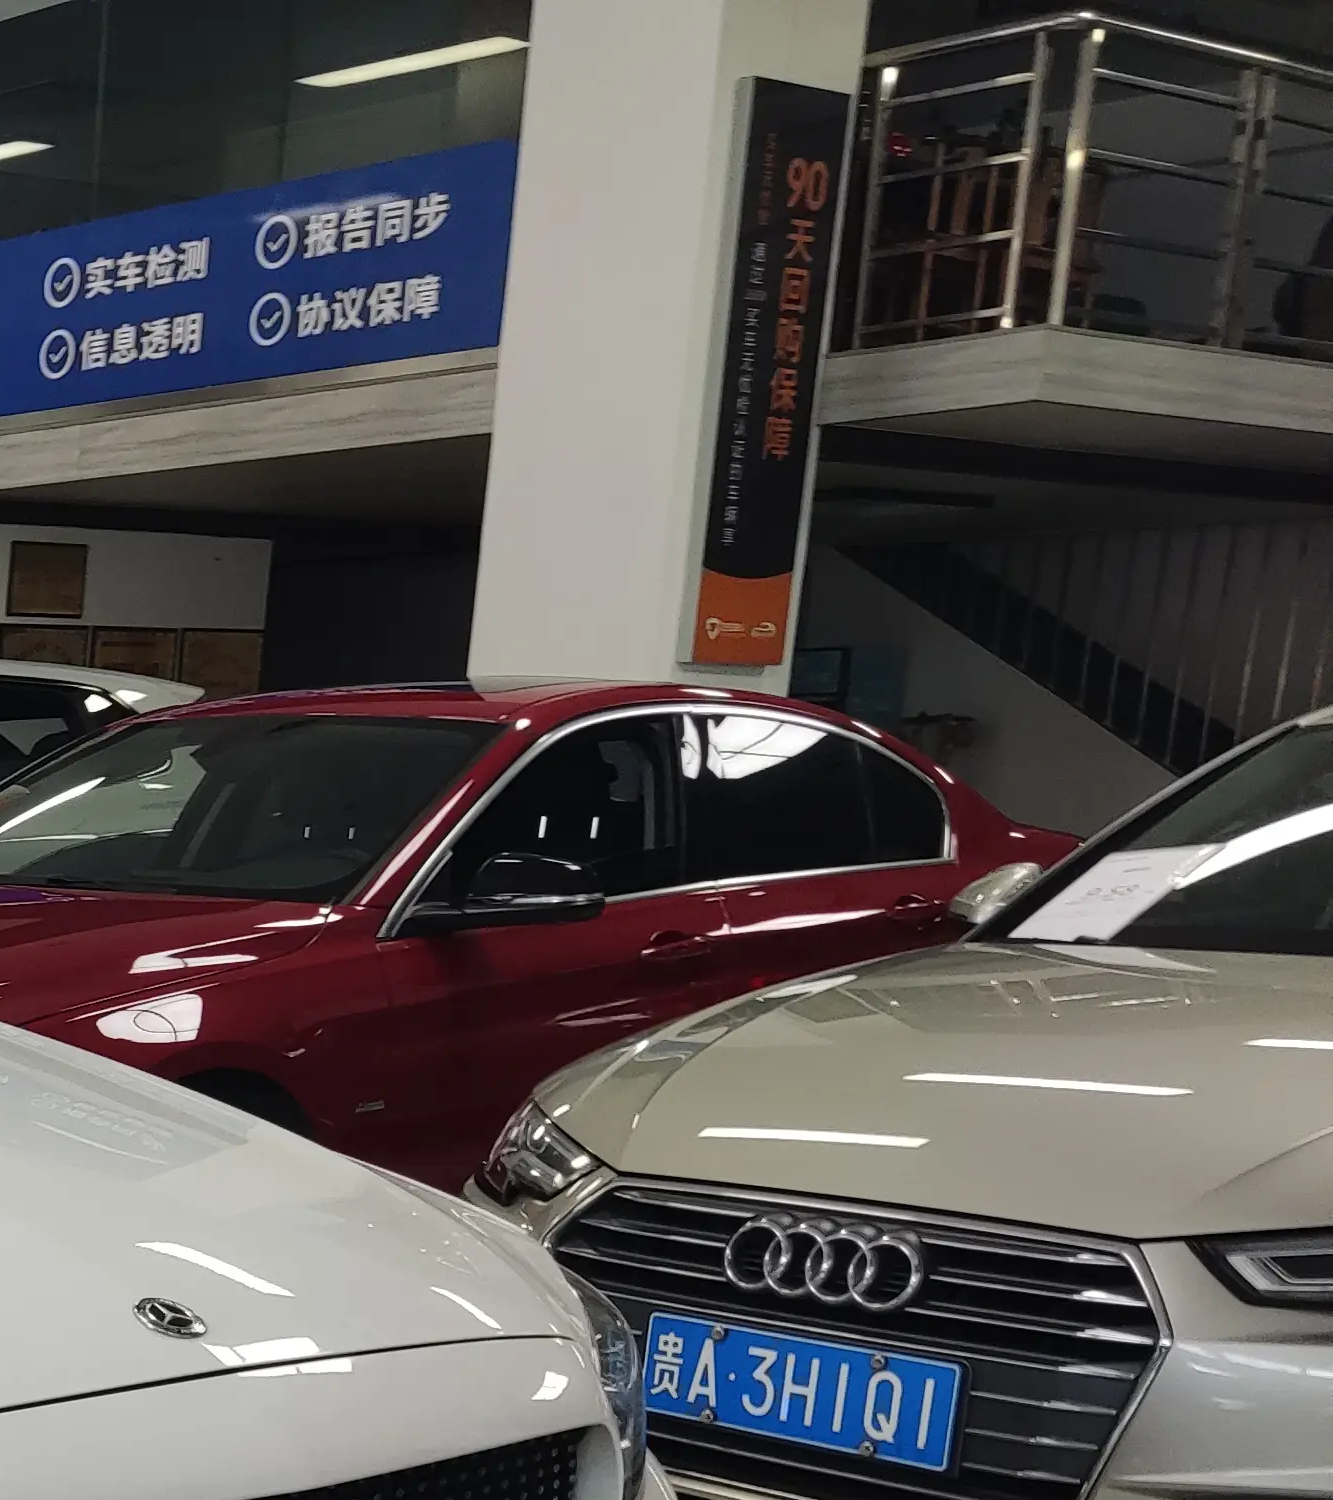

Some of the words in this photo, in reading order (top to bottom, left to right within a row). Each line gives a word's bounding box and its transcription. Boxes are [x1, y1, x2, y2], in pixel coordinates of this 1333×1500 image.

[302, 192, 451, 260] 报告同步
[84, 236, 211, 300] 实车检测
[296, 273, 443, 339] 协议保障
[78, 312, 205, 372] 信息透明
